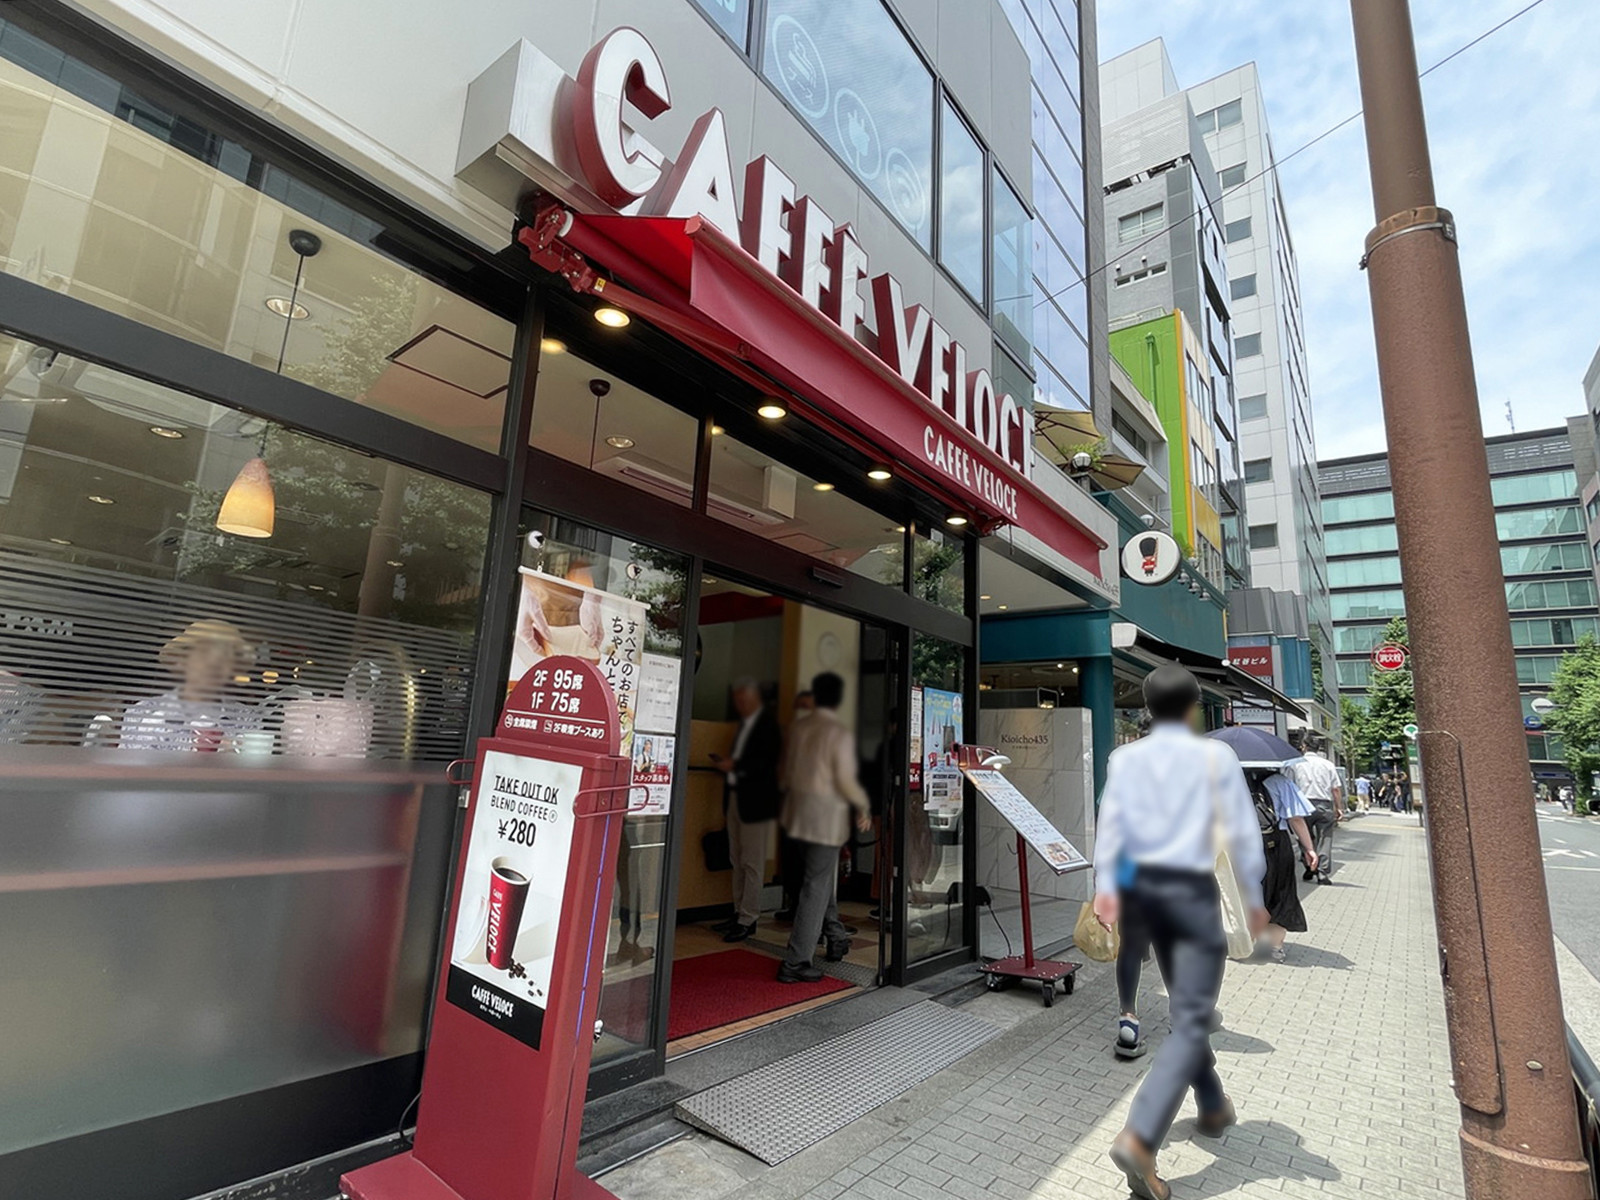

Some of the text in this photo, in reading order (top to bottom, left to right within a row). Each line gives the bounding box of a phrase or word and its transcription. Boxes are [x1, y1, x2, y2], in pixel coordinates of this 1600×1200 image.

[972, 458, 1018, 520] VELOCE
[533, 668, 584, 690] 2F 95席
[531, 691, 581, 713] 1F 75席
[494, 775, 560, 805] TAKE OUT OK
[491, 794, 516, 812] BLEND
[517, 801, 549, 821] COFFEE
[498, 817, 537, 847] ¥280
[490, 993, 514, 1018] VELOCE
